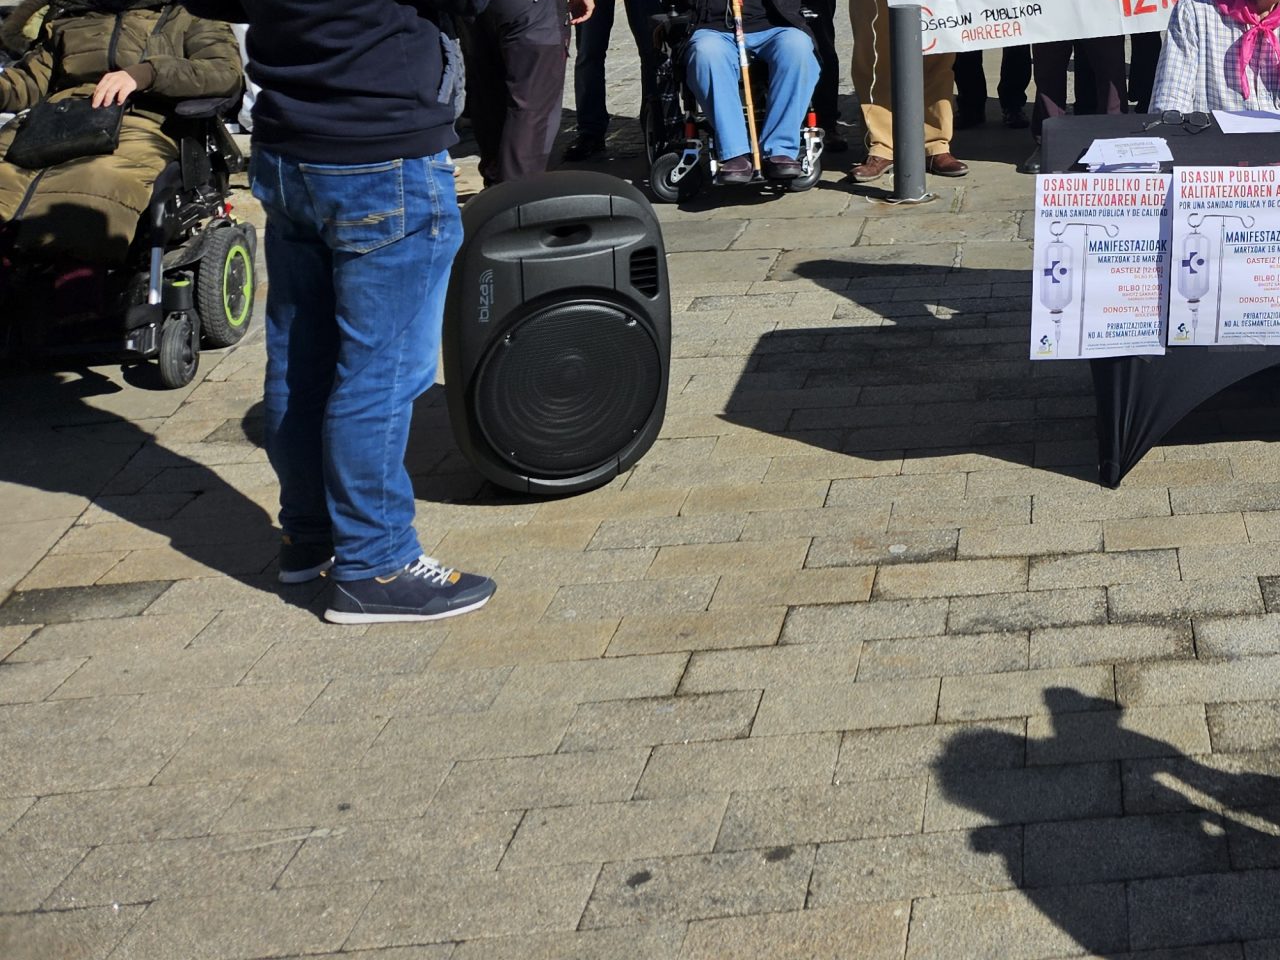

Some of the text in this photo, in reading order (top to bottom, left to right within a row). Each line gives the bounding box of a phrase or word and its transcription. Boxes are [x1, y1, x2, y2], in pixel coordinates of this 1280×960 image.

[921, 4, 1042, 31] OSASUN PUBLIKOA
[962, 21, 1022, 42] AURRERA
[1181, 171, 1224, 183] OSASUN
[1230, 170, 1274, 182] PUBLIKO
[1044, 179, 1164, 191] OSASUN PUBLIKO ETA
[1181, 185, 1271, 198] KALITATEZKOAREN
[1043, 194, 1166, 206] KALITATEZKOAREN ALDE
[1207, 201, 1233, 209] SANIDAD
[1262, 200, 1266, 208] Y
[1268, 200, 1275, 208] DE
[1142, 208, 1167, 216] CALIDAD
[1089, 240, 1167, 252] MANIFESTAZIOAK
[1133, 255, 1140, 263] 16
[1143, 255, 1162, 263] MARZO
[478, 284, 489, 322] ibiza
